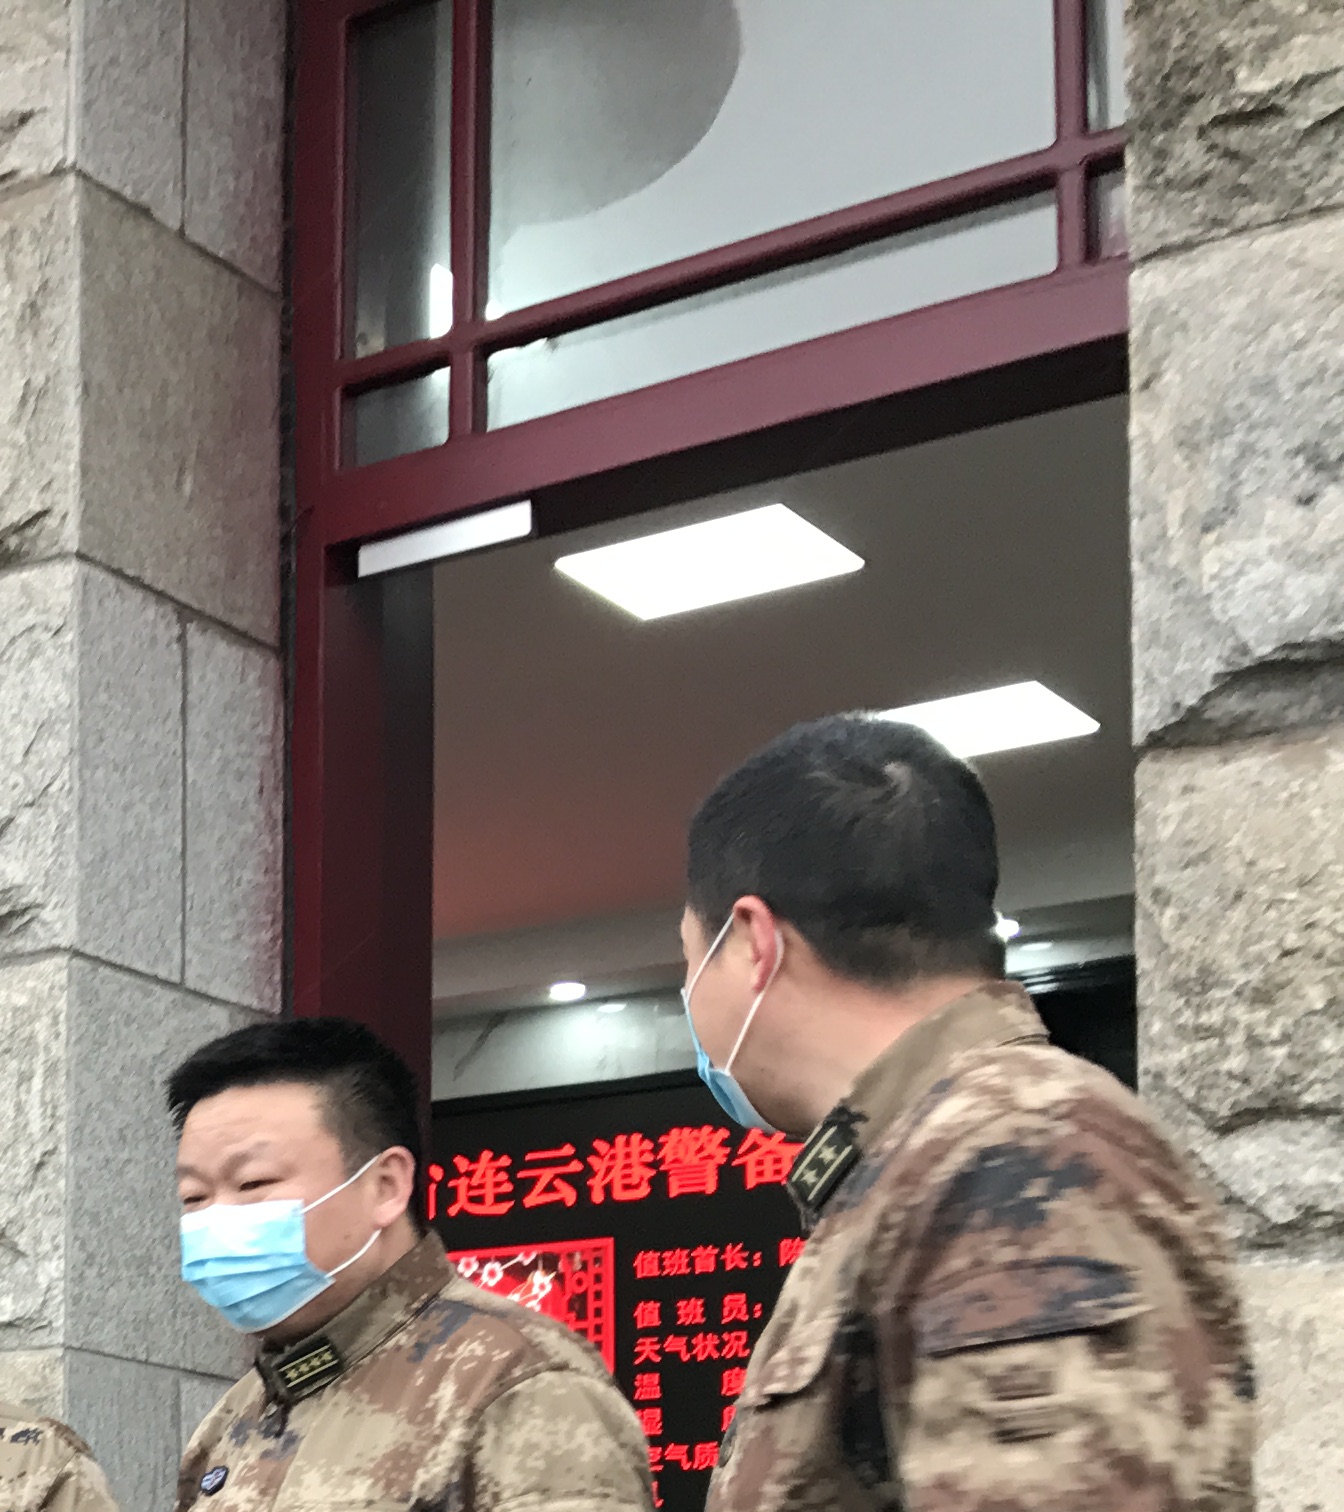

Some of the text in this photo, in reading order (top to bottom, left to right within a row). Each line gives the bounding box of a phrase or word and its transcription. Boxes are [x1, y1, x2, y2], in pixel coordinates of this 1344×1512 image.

[427, 1126, 806, 1221] 连云港警备
[633, 1330, 751, 1366] 天气状况
